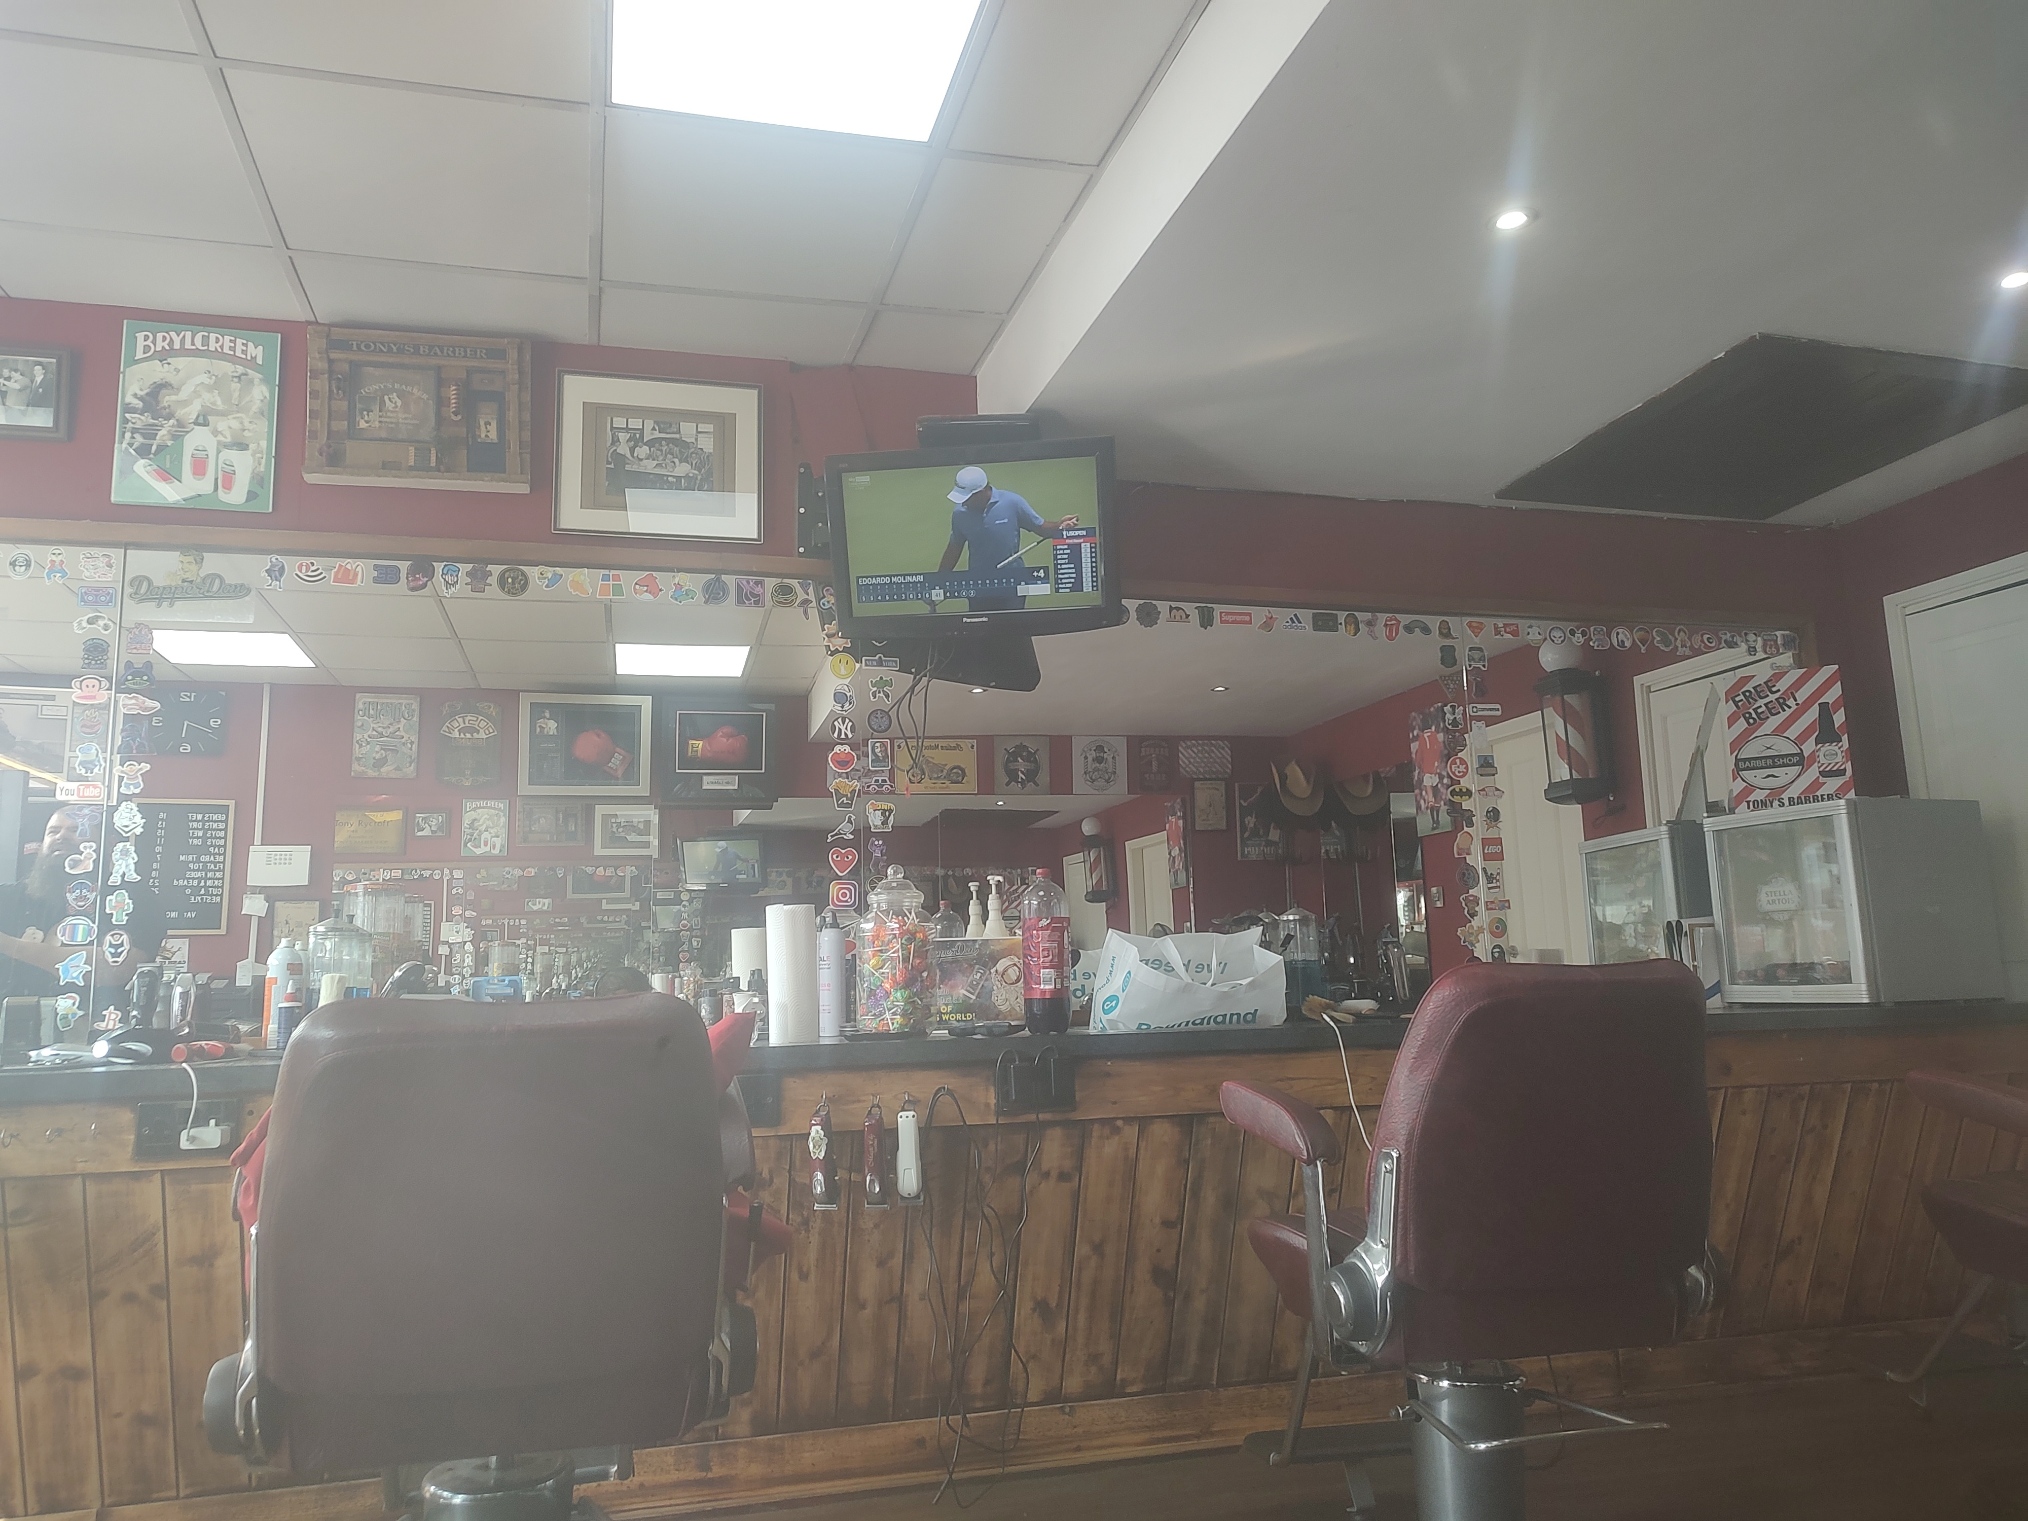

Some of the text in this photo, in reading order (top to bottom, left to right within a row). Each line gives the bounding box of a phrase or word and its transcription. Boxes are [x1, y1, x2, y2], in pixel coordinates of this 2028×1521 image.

[134, 331, 263, 365] BRYLCREEM
[349, 341, 487, 359] TONY'S BARBER
[1032, 569, 1045, 578] +4
[199, 573, 248, 598] Dan
[858, 577, 891, 585] EDOARDO
[892, 575, 924, 584] MOLINARI
[1221, 612, 1251, 622] Supreme
[1282, 623, 1308, 631] adidas
[1730, 678, 1781, 710] FREE
[1741, 691, 1801, 727] BEER!
[1738, 756, 1800, 769] BARBER SHOP
[59, 785, 101, 797] YouTube
[1745, 797, 1785, 810] TONY'S
[1484, 845, 1501, 853] LEGO
[1764, 889, 1794, 899] STELLA
[1765, 898, 1795, 906] ARTOIS
